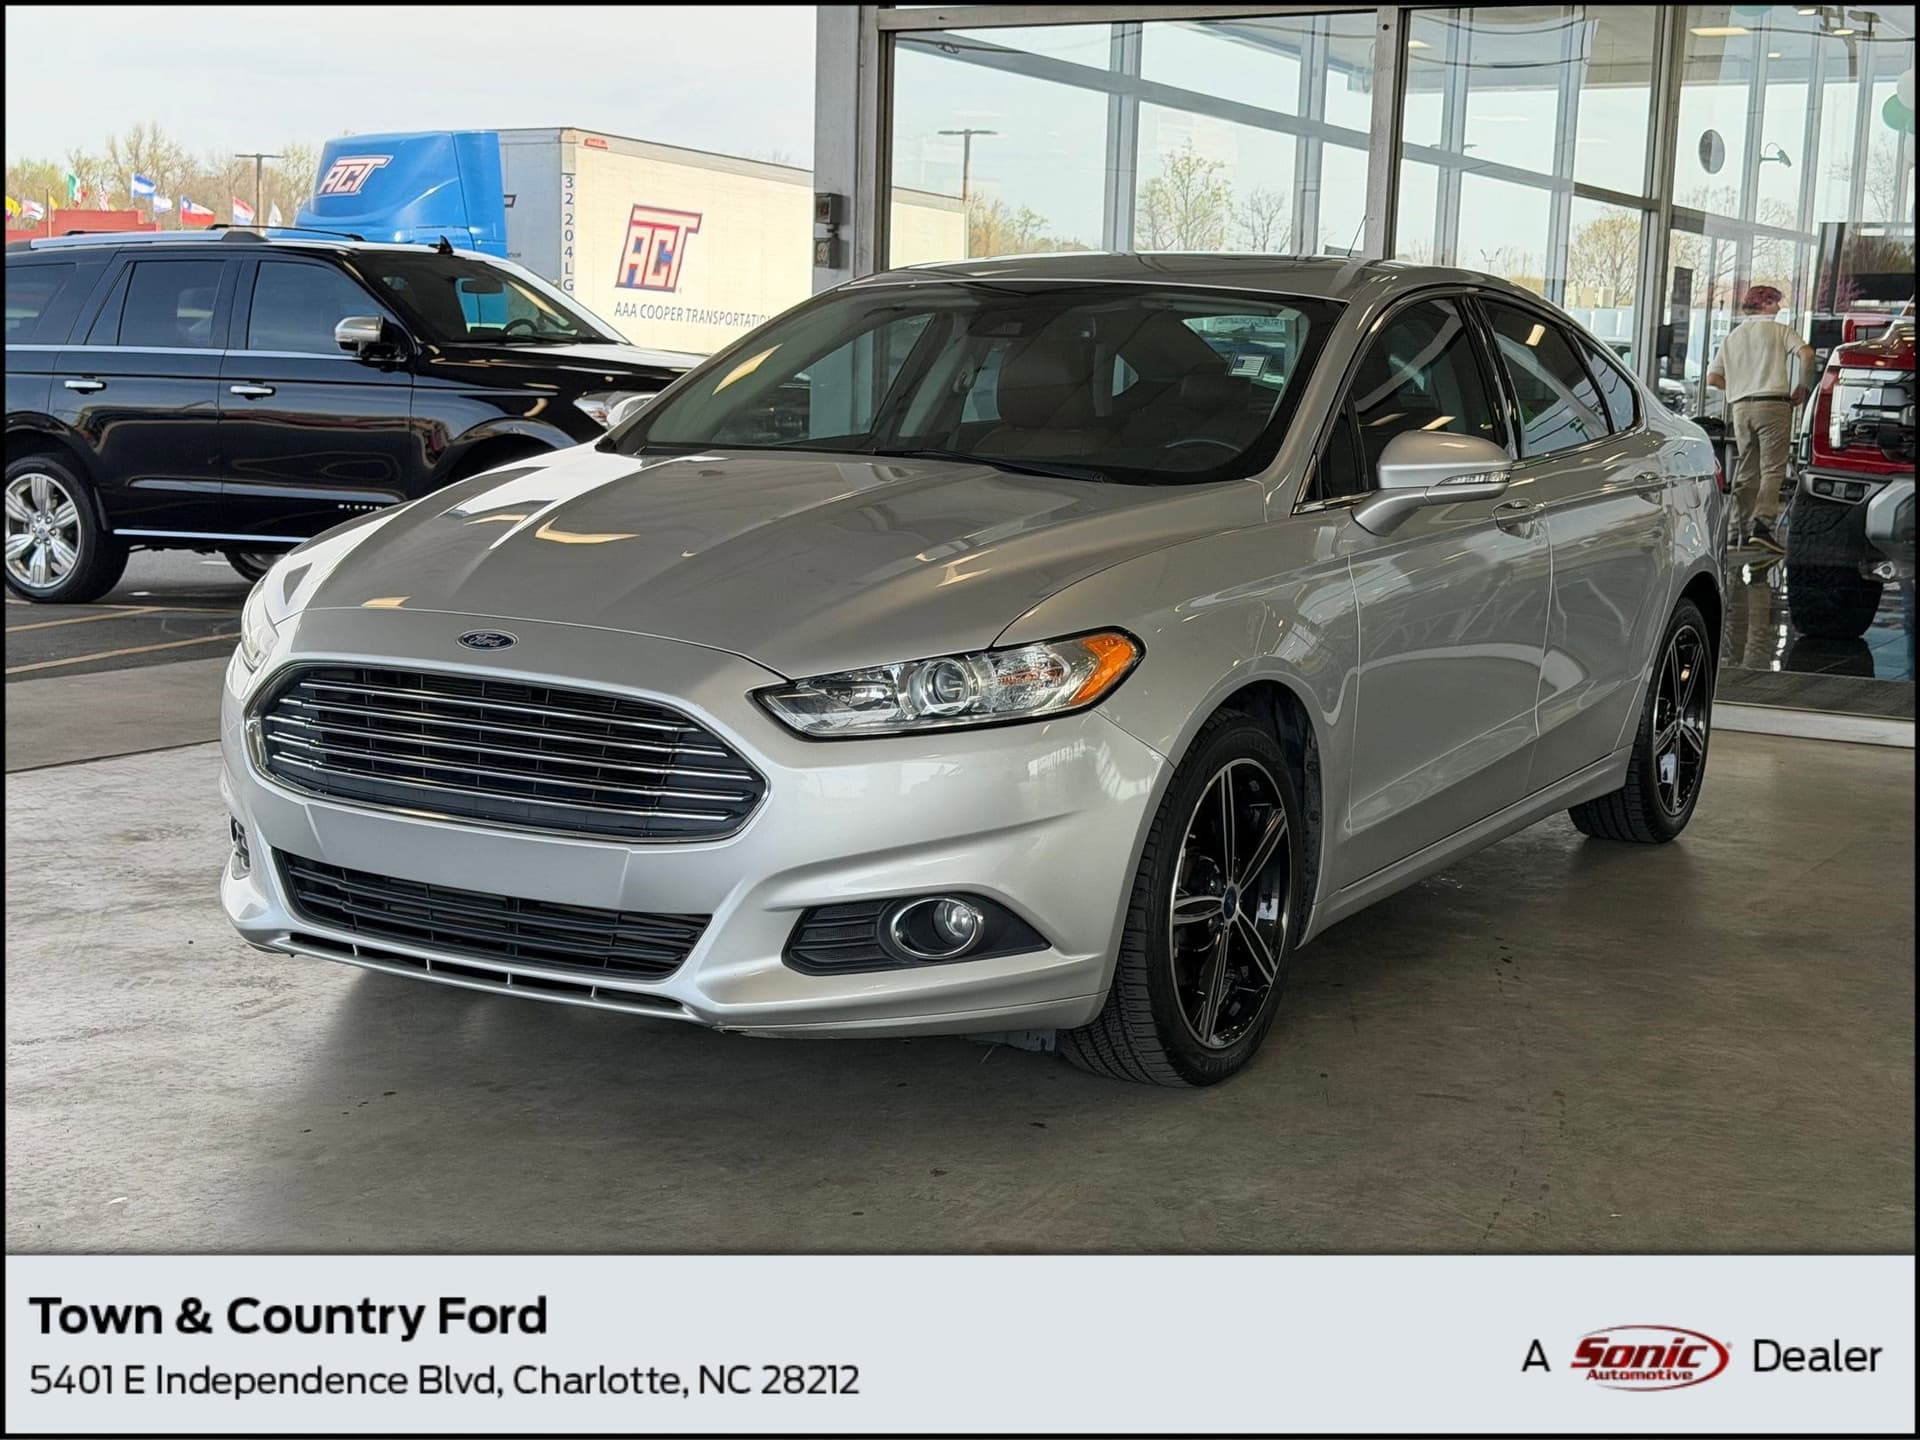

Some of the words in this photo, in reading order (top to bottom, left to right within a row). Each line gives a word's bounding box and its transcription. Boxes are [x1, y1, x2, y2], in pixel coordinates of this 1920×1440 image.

[319, 156, 392, 195] ACT
[615, 203, 703, 293] ACT
[614, 301, 638, 318] AAA
[640, 303, 684, 321] COOPER
[686, 307, 772, 328] TRANSPORTATIO
[466, 632, 507, 647] Ford
